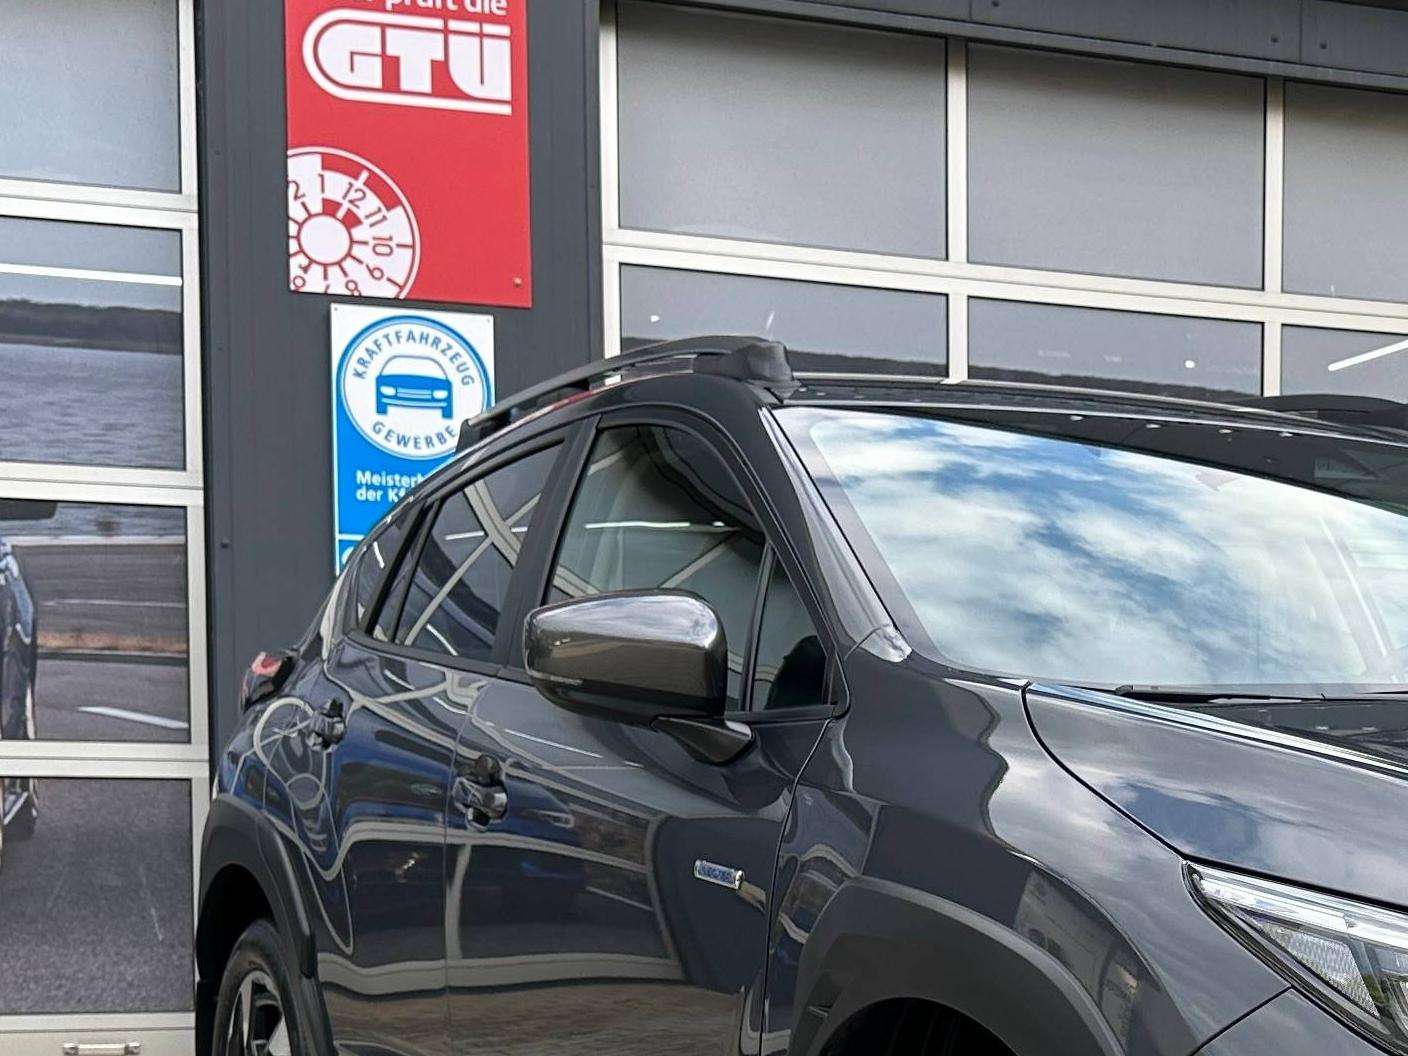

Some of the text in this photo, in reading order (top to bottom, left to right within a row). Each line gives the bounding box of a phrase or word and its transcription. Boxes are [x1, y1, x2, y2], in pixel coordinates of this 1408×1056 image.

[303, 9, 512, 115] GTÜ
[342, 181, 367, 209] 12
[365, 206, 388, 228] 11
[372, 235, 394, 256] 10
[353, 329, 475, 387] KRAFTFAHRZEUG
[371, 420, 458, 450] GEWERBE
[356, 484, 384, 502] der
